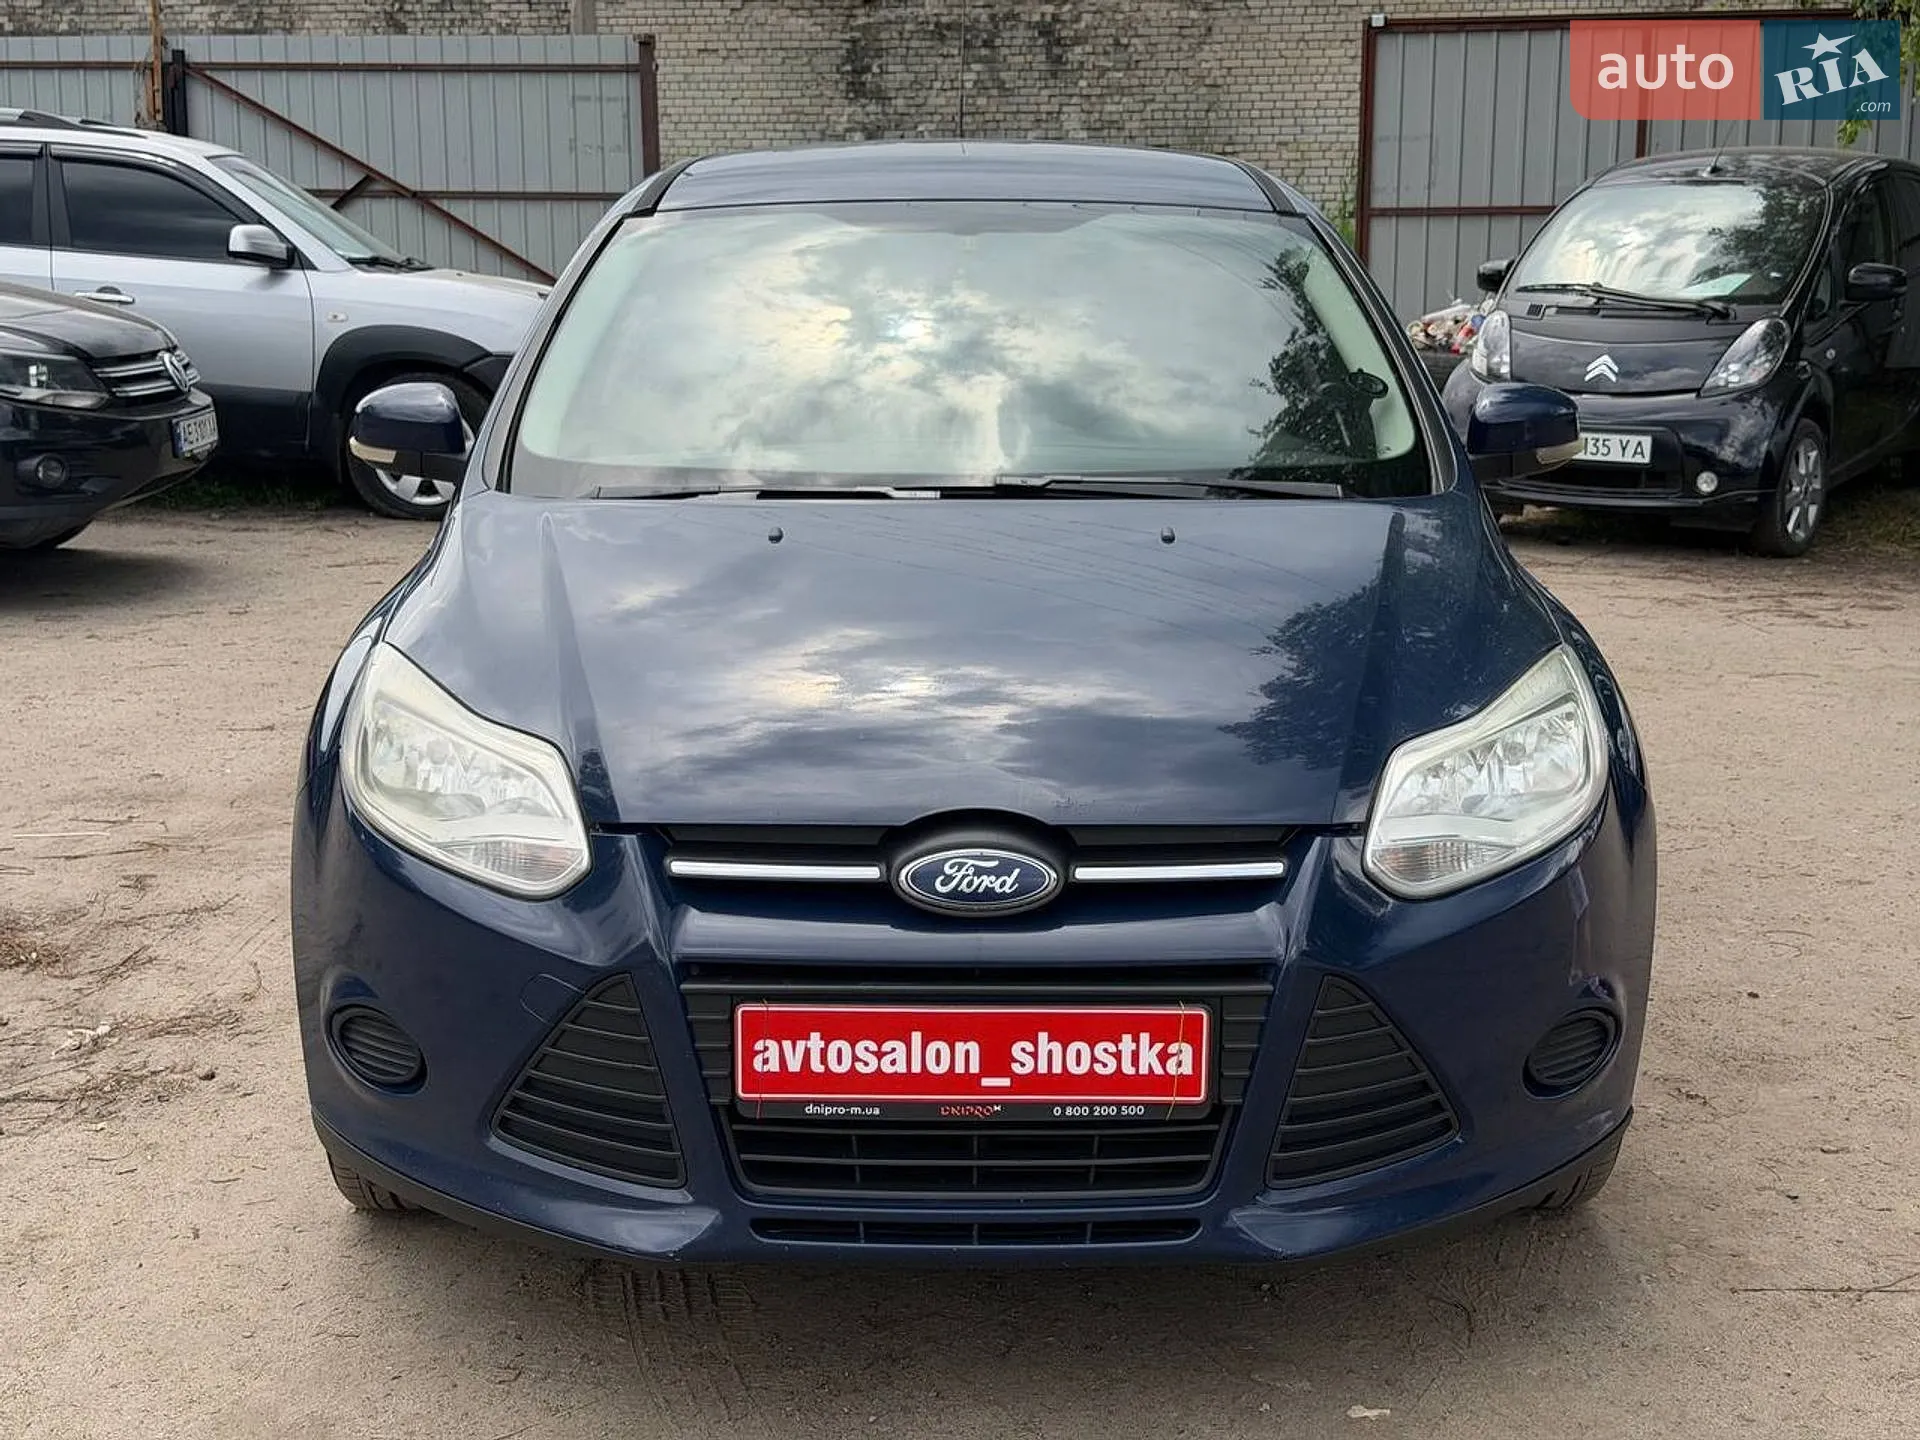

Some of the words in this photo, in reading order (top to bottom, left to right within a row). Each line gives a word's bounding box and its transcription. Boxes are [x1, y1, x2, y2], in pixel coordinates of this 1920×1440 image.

[1619, 439, 1646, 459] YA
[934, 857, 1021, 894] Ford
[752, 1030, 1194, 1088] avtosalon_shostka
[804, 1103, 881, 1117] dnipro-m.ua
[1053, 1106, 1061, 1116] 0
[1065, 1106, 1089, 1116] 800
[1093, 1105, 1117, 1116] 200
[1121, 1105, 1145, 1116] 500
